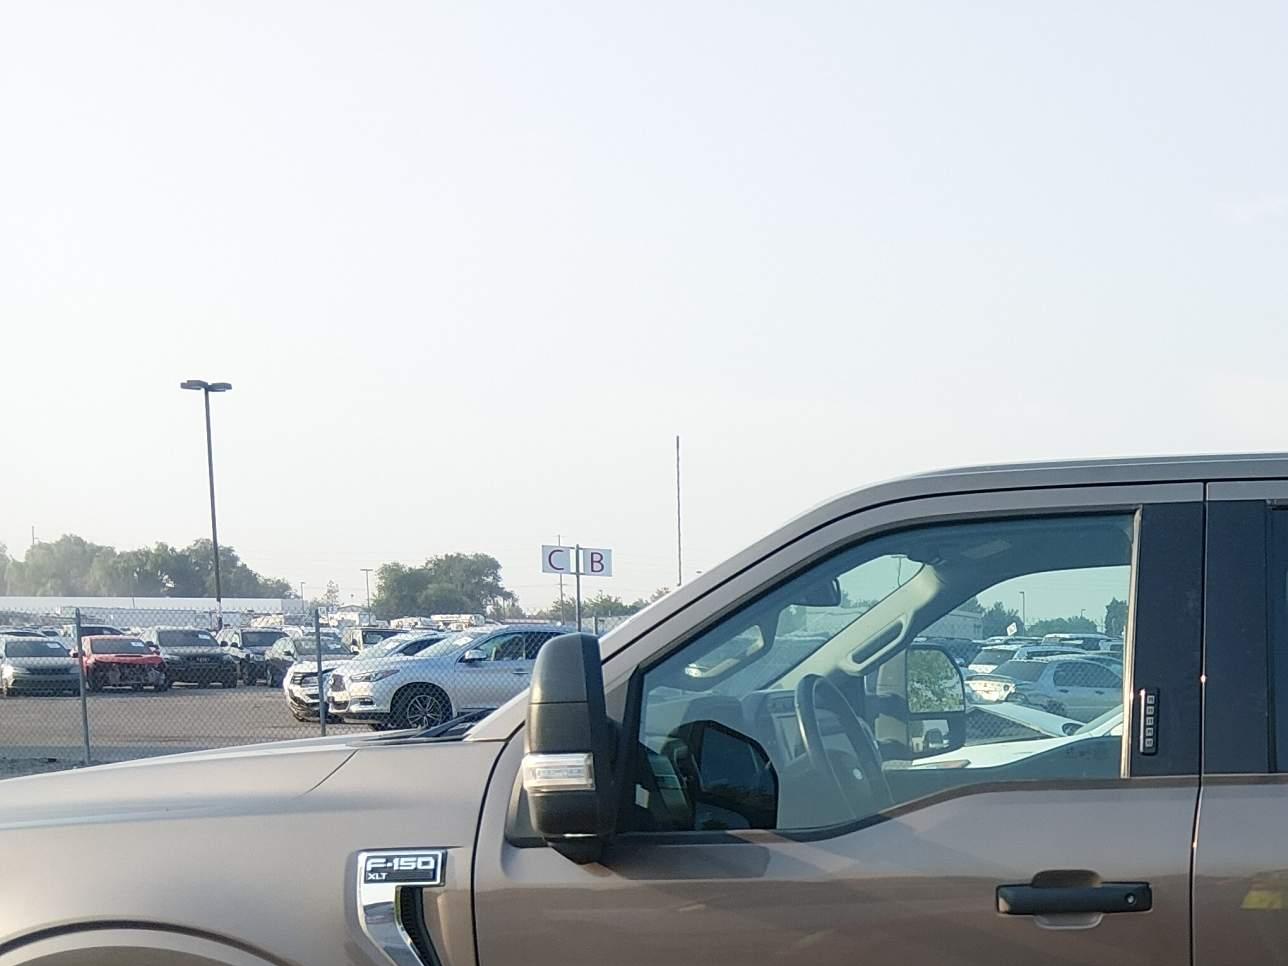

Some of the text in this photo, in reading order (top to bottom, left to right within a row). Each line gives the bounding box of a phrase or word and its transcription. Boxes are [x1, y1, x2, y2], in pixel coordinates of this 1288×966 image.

[548, 549, 564, 570] C
[590, 552, 605, 573] B
[366, 856, 435, 871] F-150
[367, 872, 388, 880] XLT
